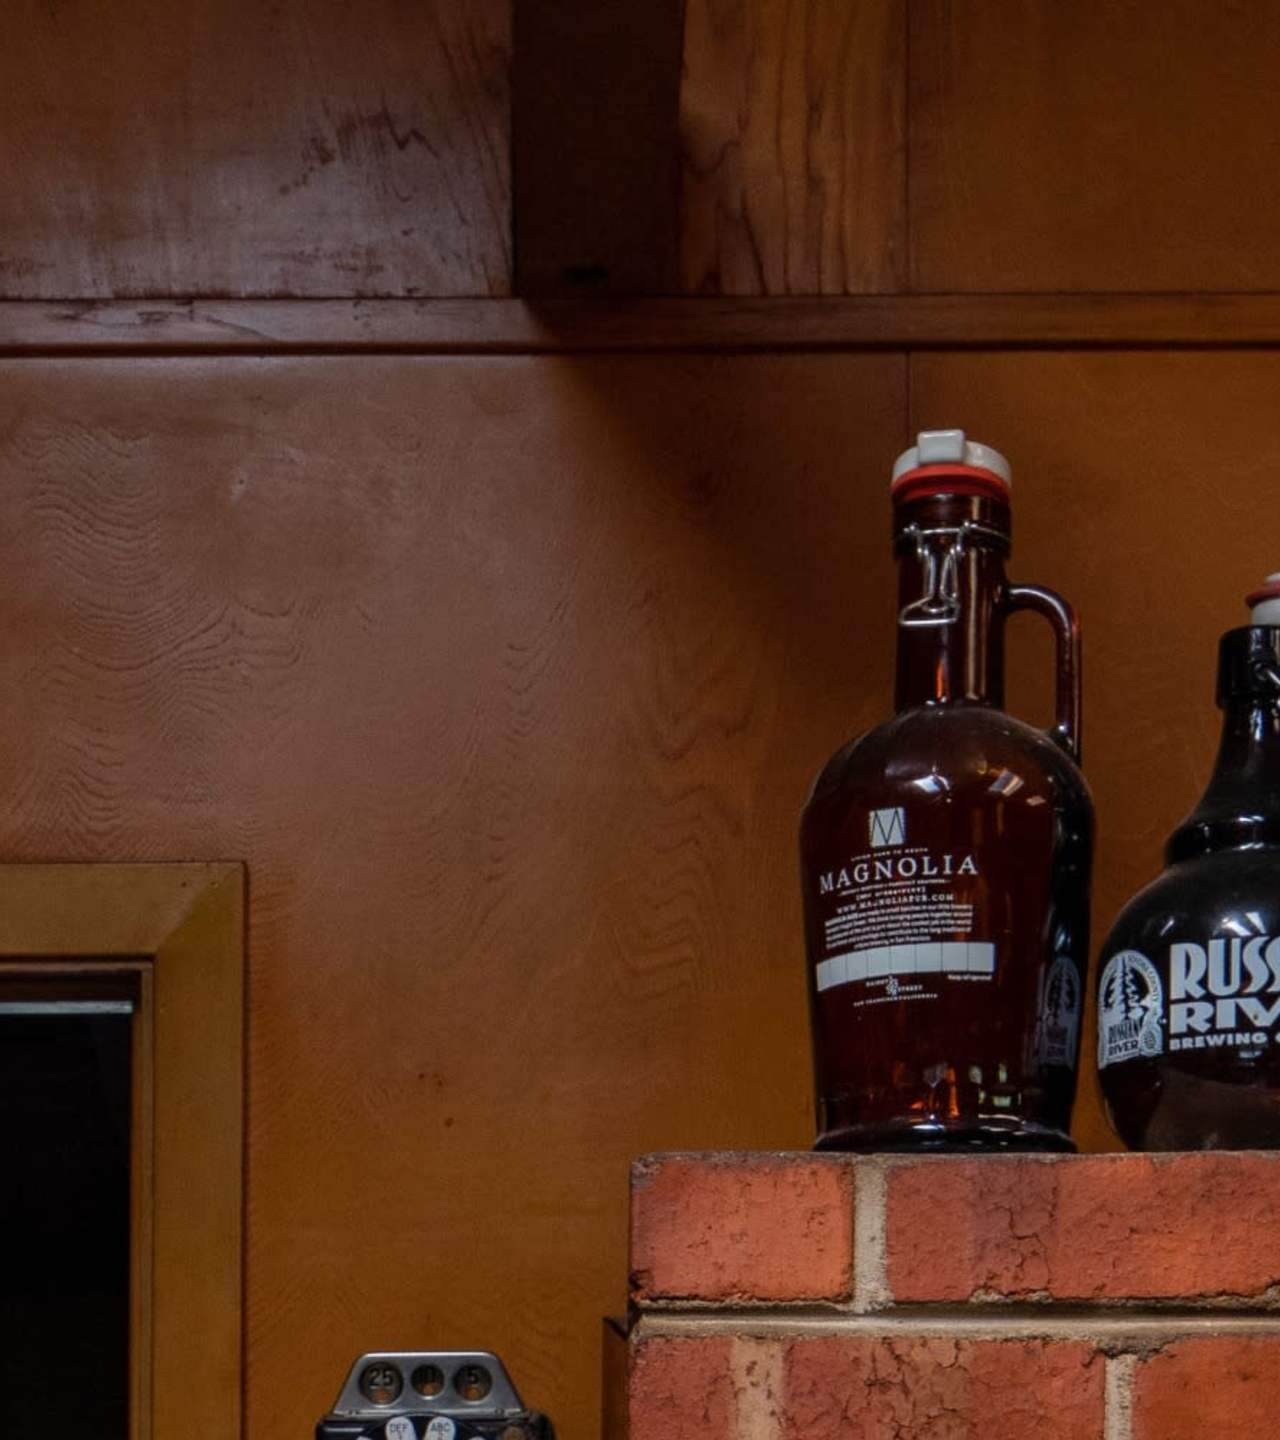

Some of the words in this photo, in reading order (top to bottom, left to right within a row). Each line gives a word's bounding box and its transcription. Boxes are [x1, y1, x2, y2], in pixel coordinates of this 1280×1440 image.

[820, 855, 978, 894] MAGNOLIA
[1170, 1031, 1268, 1051] BREWING
[389, 1423, 408, 1433] DEF
[430, 1421, 450, 1432] ABC
